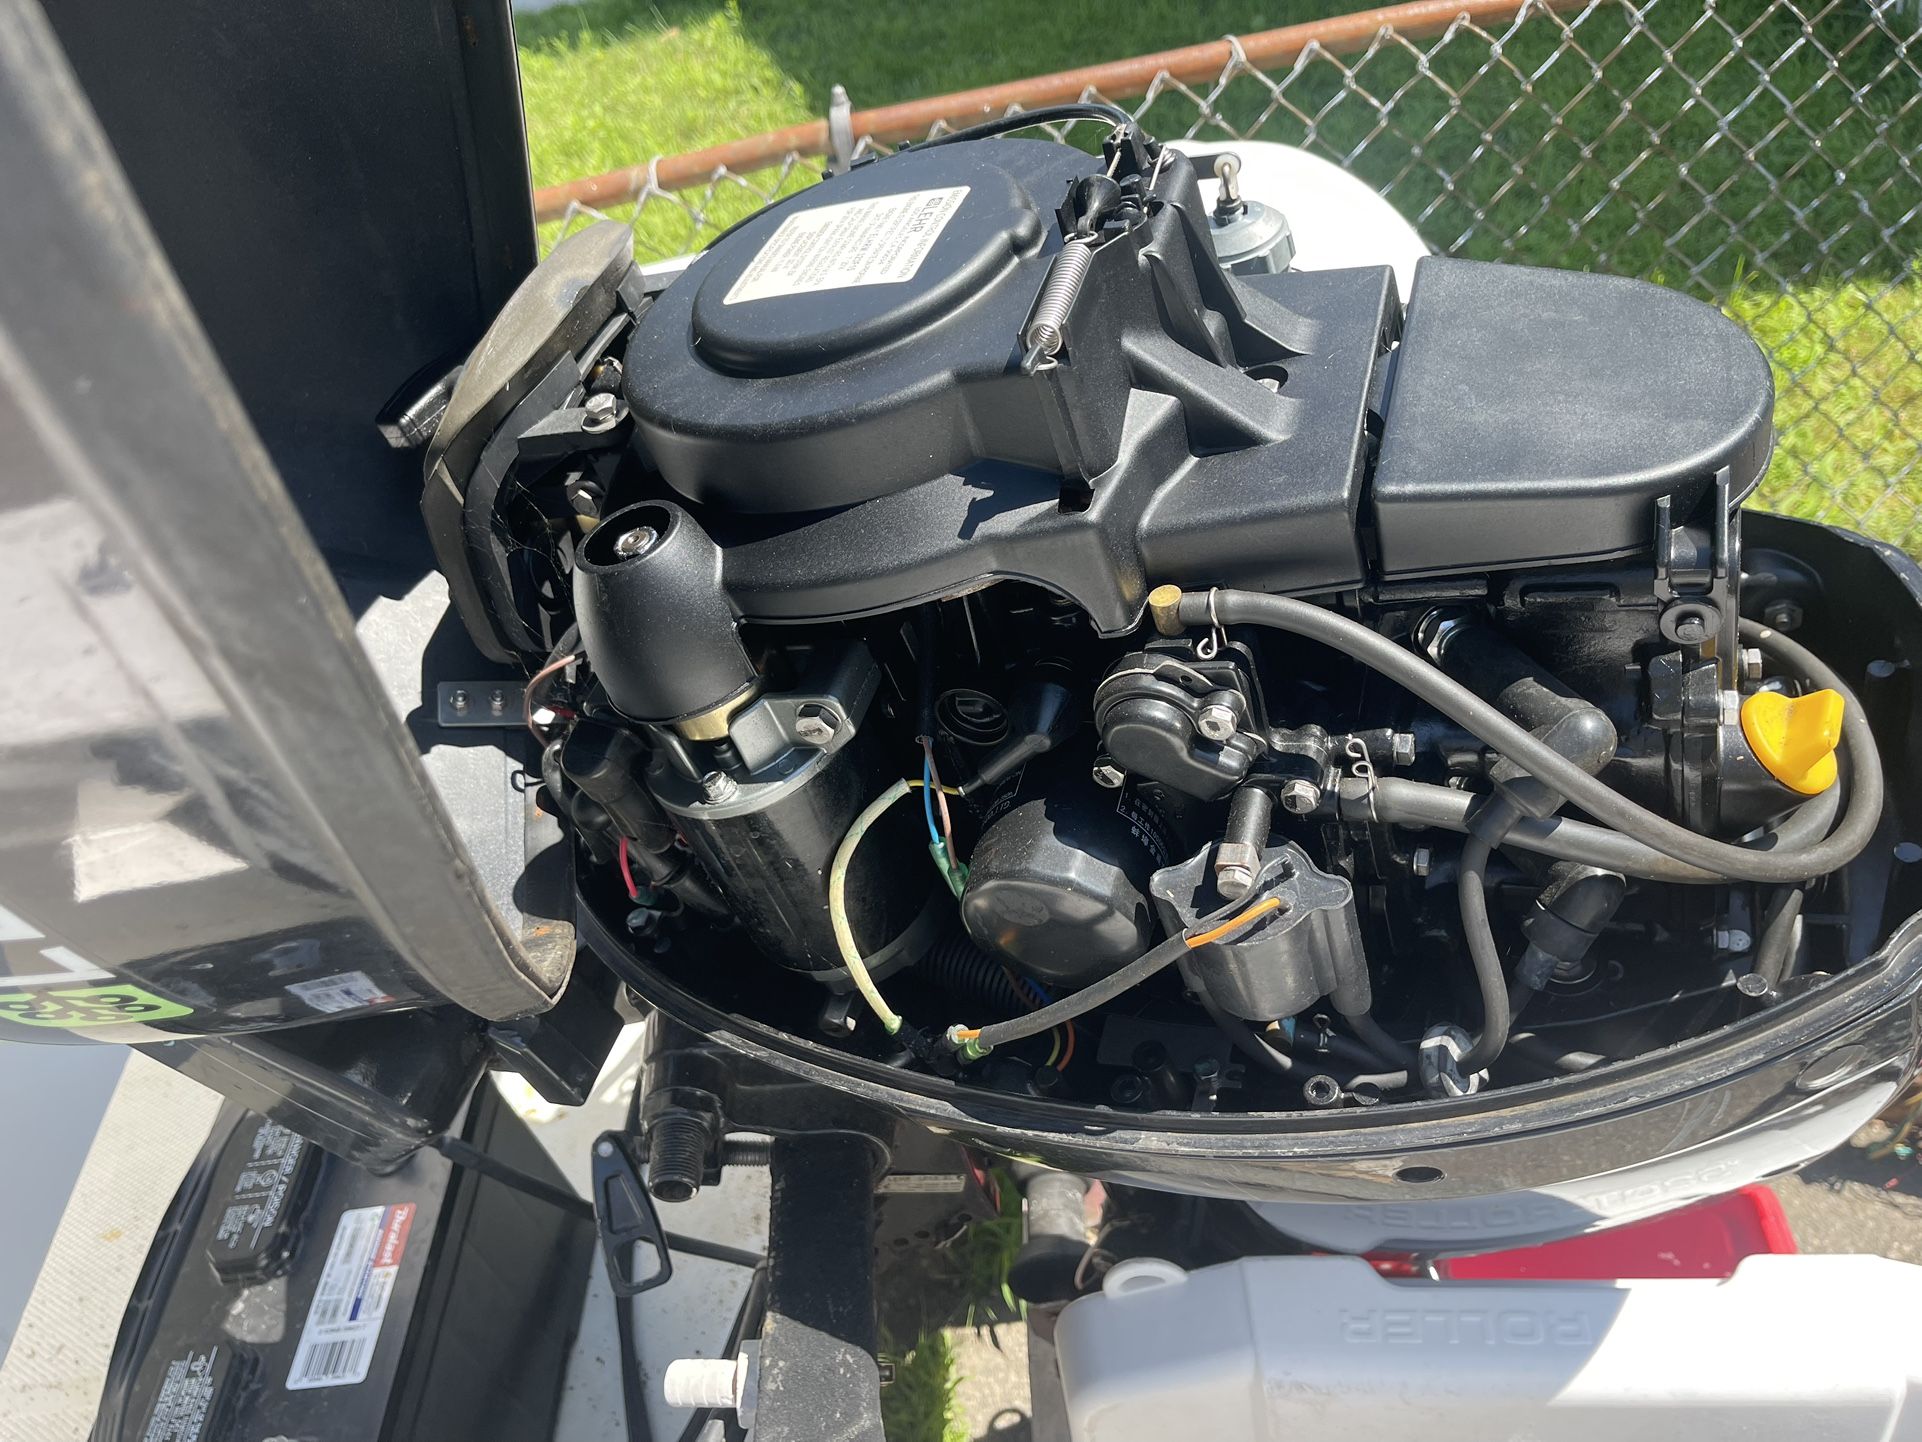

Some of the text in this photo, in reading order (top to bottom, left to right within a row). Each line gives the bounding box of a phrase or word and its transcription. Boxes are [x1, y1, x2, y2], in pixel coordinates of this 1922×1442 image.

[905, 204, 939, 234] LEHR
[384, 1205, 410, 1265] Duralast
[1339, 1309, 1593, 1345] ROLLER
